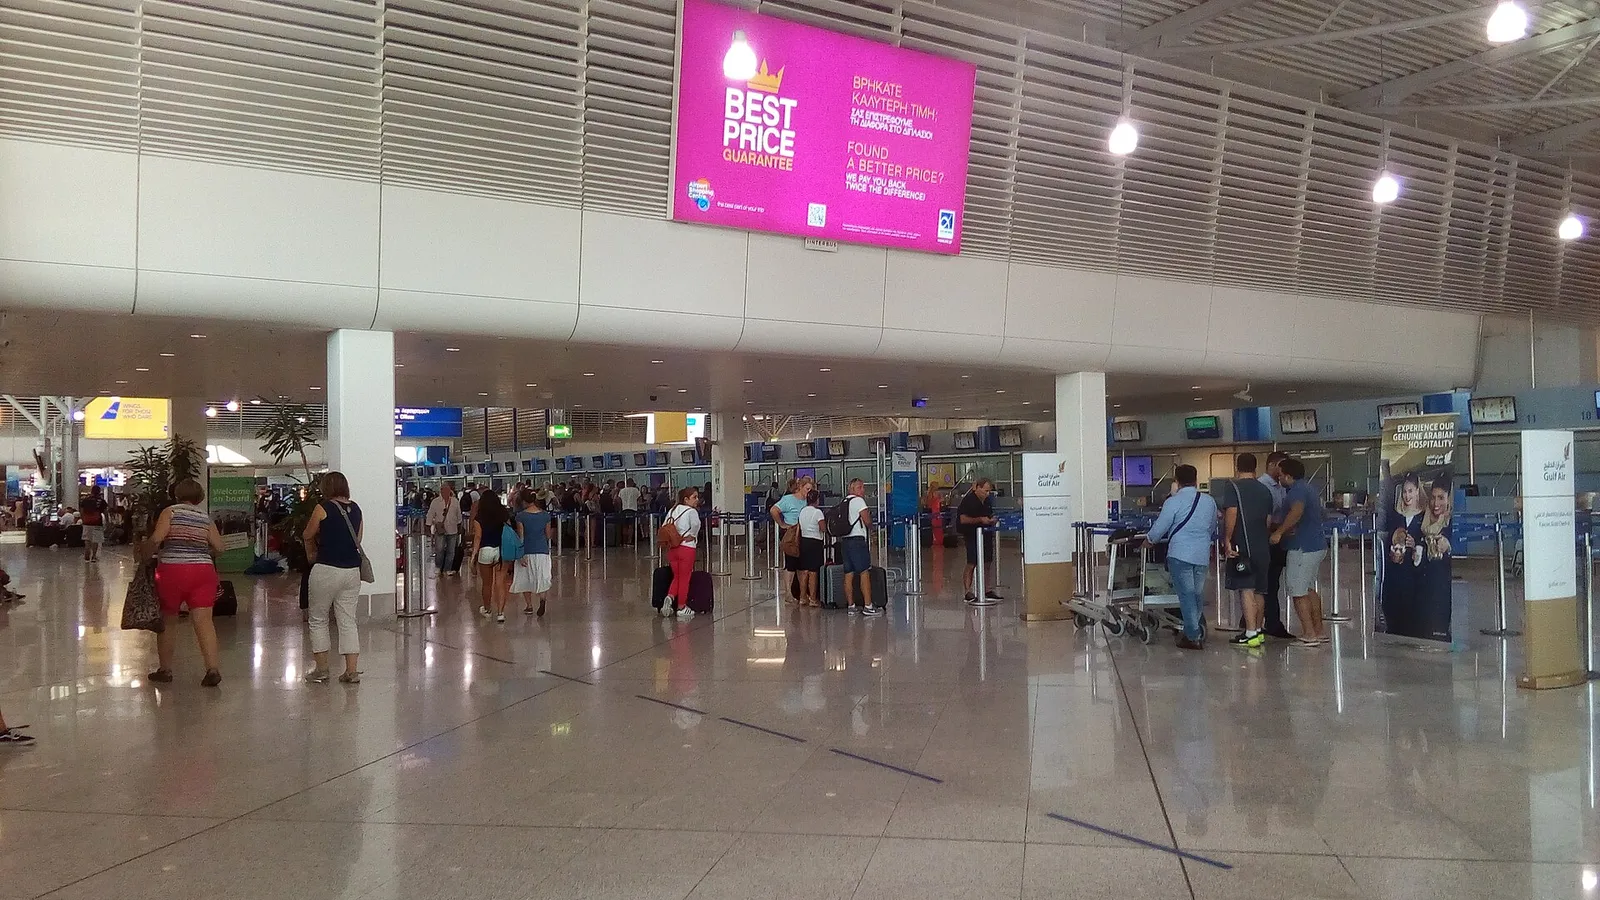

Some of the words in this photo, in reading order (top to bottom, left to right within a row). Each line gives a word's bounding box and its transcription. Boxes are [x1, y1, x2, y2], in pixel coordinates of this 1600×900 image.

[853, 76, 902, 98] ΒΡΗΚΑΤΕ
[724, 87, 798, 129] BEST
[851, 107, 864, 118] ΣΑΣ
[852, 92, 907, 114] ΚΑΛΥΤΕΡΗ
[723, 119, 796, 157] PRICE
[722, 148, 793, 171] GUARANTEE
[847, 141, 889, 160] FOUND
[846, 157, 855, 169] A
[858, 159, 902, 178] BETTER
[905, 166, 944, 184] PRICE?
[845, 172, 857, 182] WE
[858, 174, 870, 184] PAY
[872, 176, 887, 187] YOU
[888, 179, 906, 190] BACK
[845, 181, 867, 192] TWICE
[869, 185, 882, 195] THE
[883, 187, 926, 201] DIFFERENCE!
[1393, 432, 1423, 441] GENUINE
[1423, 431, 1455, 440] ARABIAN
[1397, 423, 1438, 433] EXPERIENCE
[1439, 422, 1455, 430] OUR
[1408, 440, 1454, 449] HOSPITALITY.
[1543, 472, 1557, 481] Gulf
[1557, 472, 1566, 481] Air
